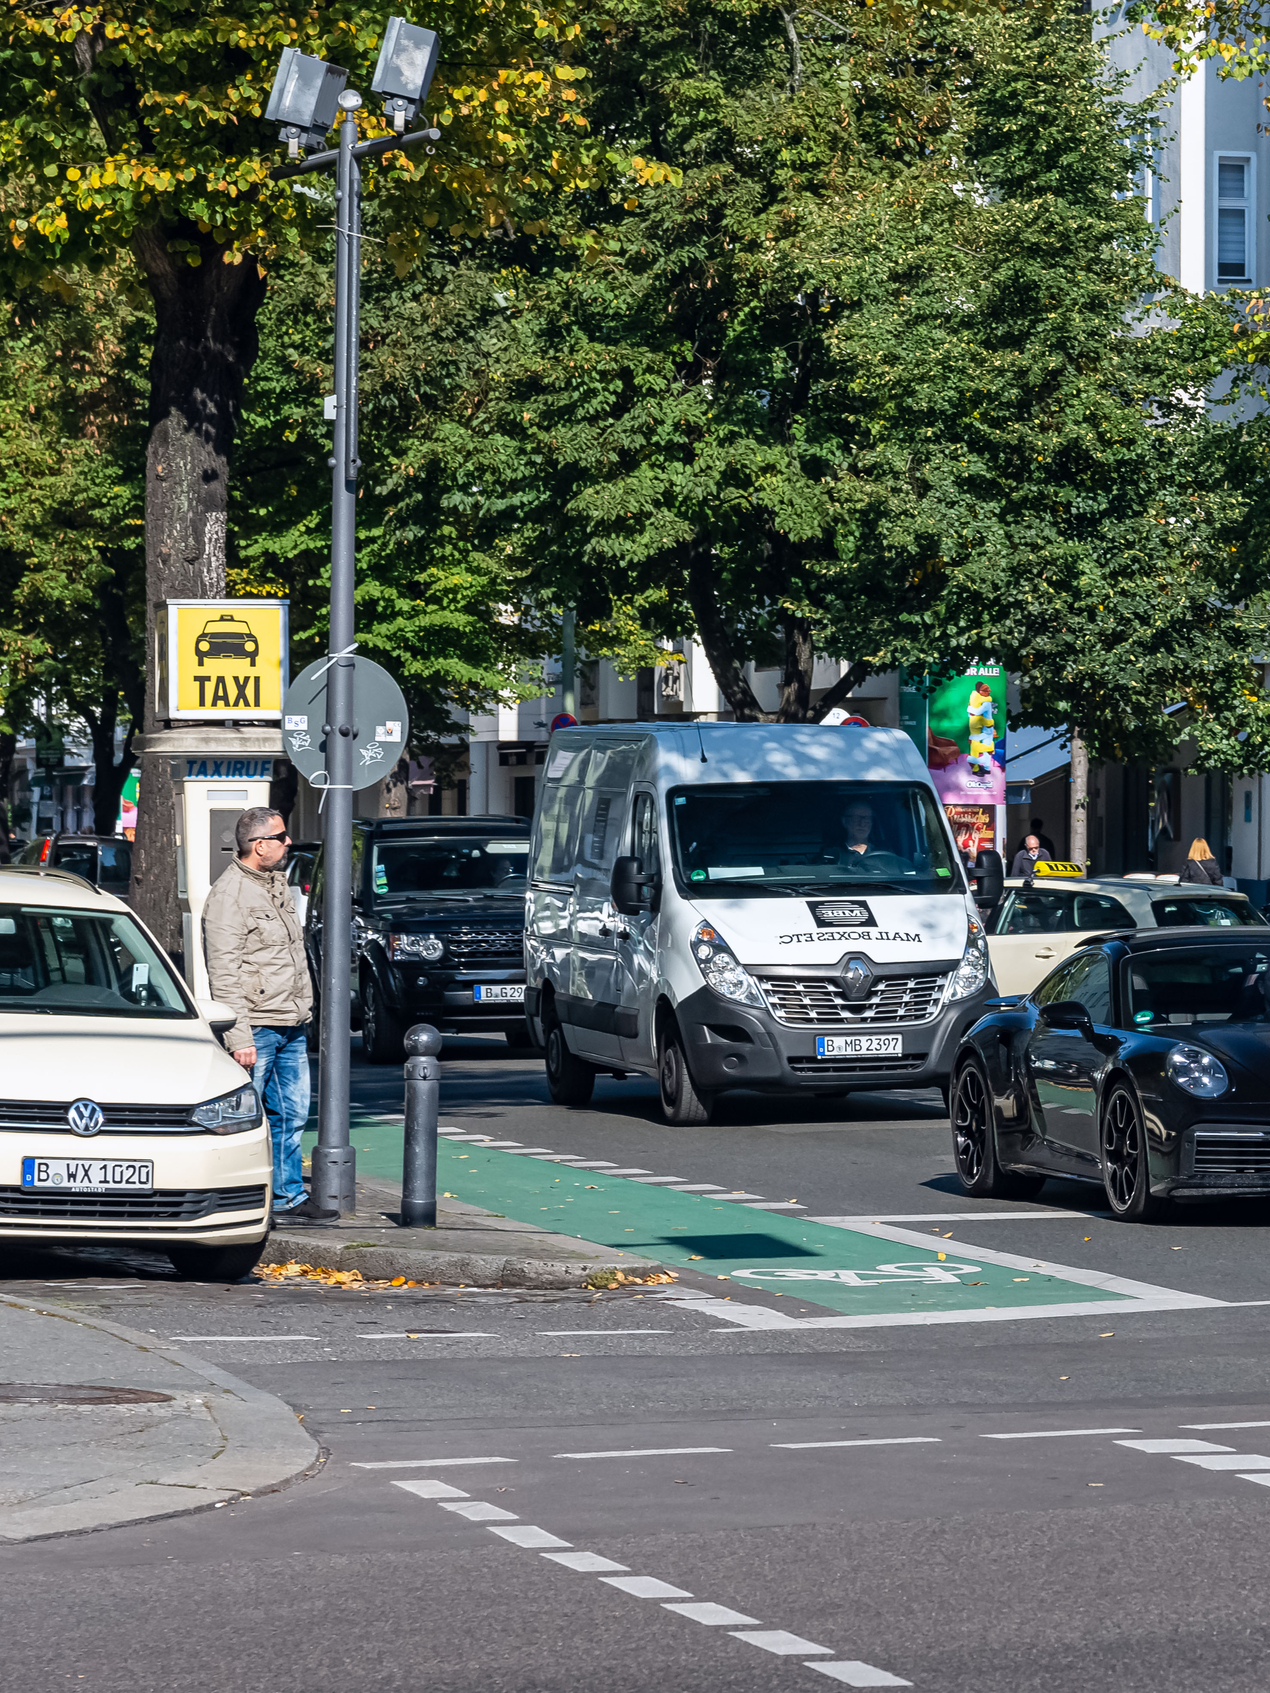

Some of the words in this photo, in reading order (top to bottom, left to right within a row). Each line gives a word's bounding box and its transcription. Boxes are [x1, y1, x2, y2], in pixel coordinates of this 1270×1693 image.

[193, 675, 261, 708] TAXI
[186, 760, 272, 778] TAXIRUF
[1045, 862, 1084, 873] TAXI
[485, 987, 493, 998] B
[500, 987, 508, 998] G
[826, 1039, 835, 1052] B
[844, 1039, 862, 1052] MB
[865, 1037, 899, 1051] 2397
[37, 1162, 50, 1182] B
[66, 1163, 93, 1184] WX
[99, 1164, 150, 1185] 1020
